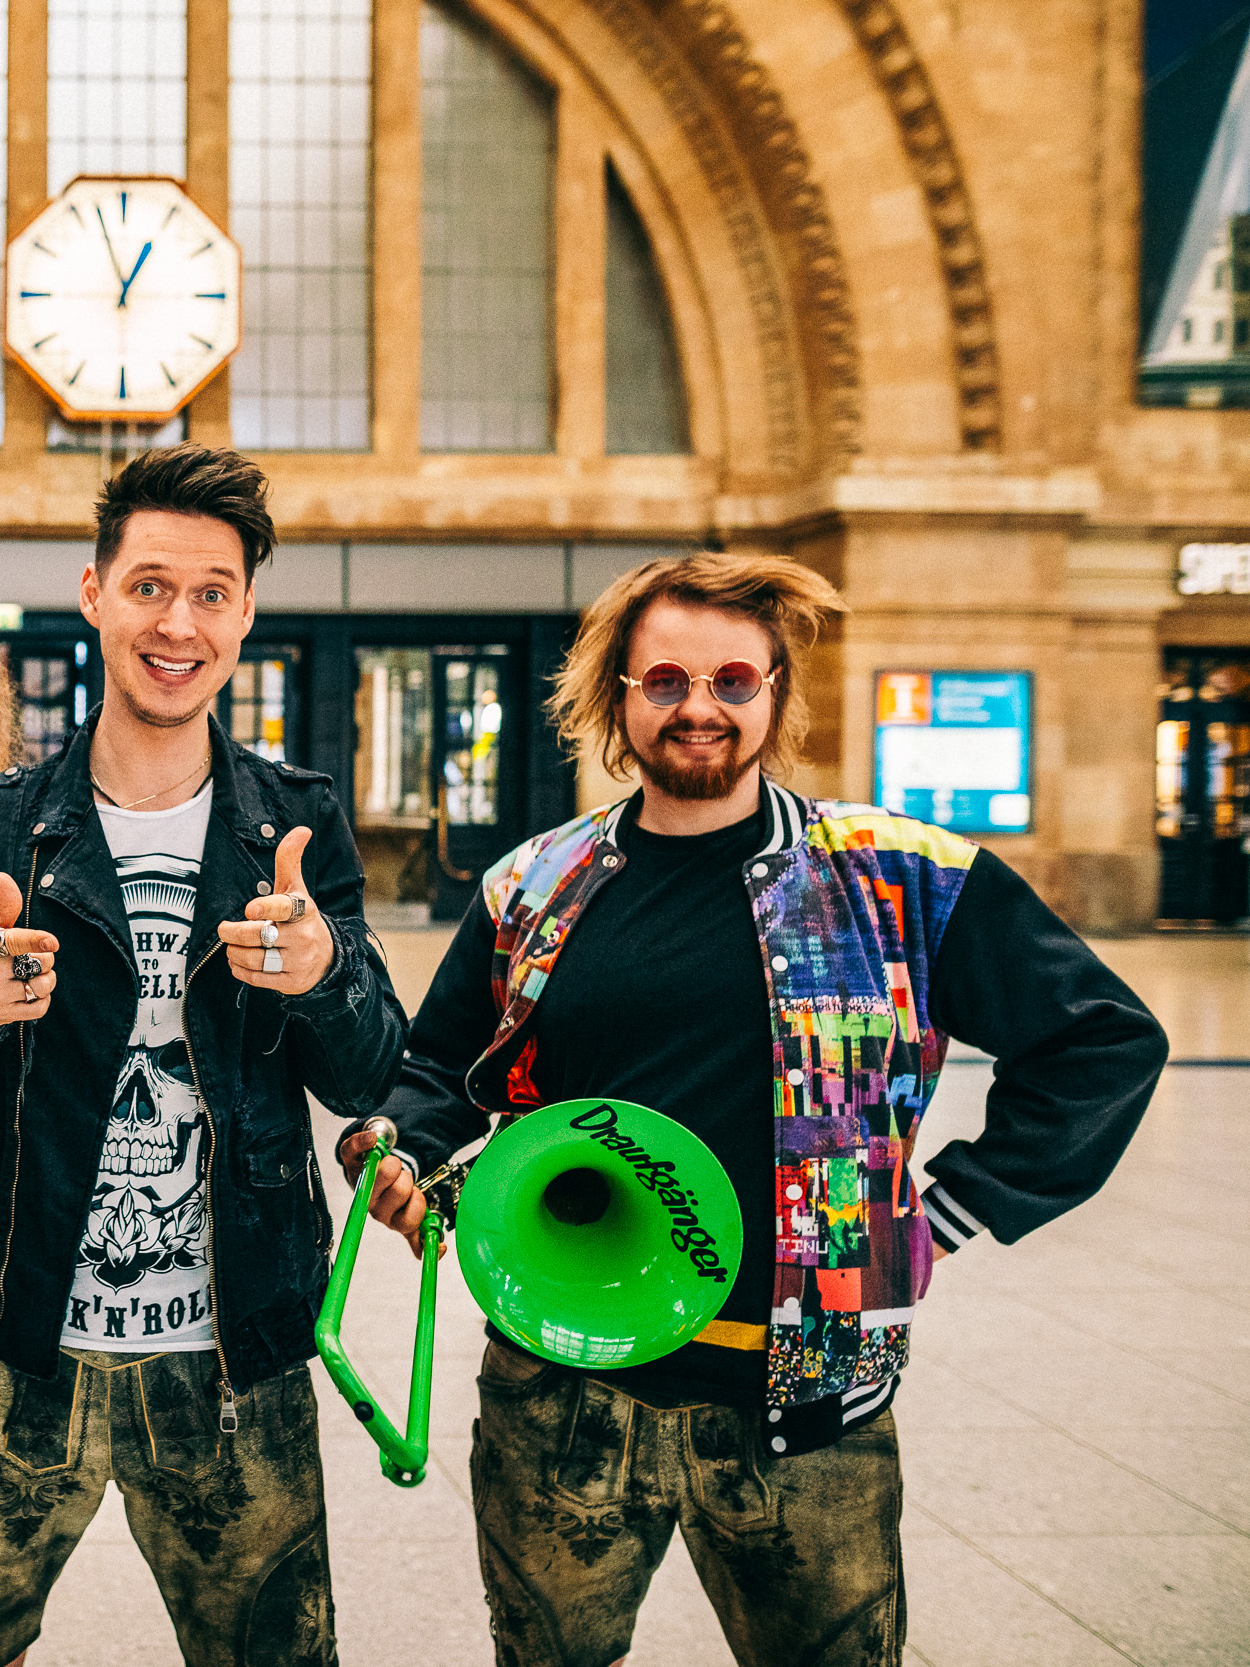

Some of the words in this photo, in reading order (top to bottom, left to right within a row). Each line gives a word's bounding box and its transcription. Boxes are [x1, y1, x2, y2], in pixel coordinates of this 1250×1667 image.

[142, 958, 159, 970] TO
[570, 1103, 728, 1283] Draufgänger
[68, 1284, 211, 1338] K'N'ROL
